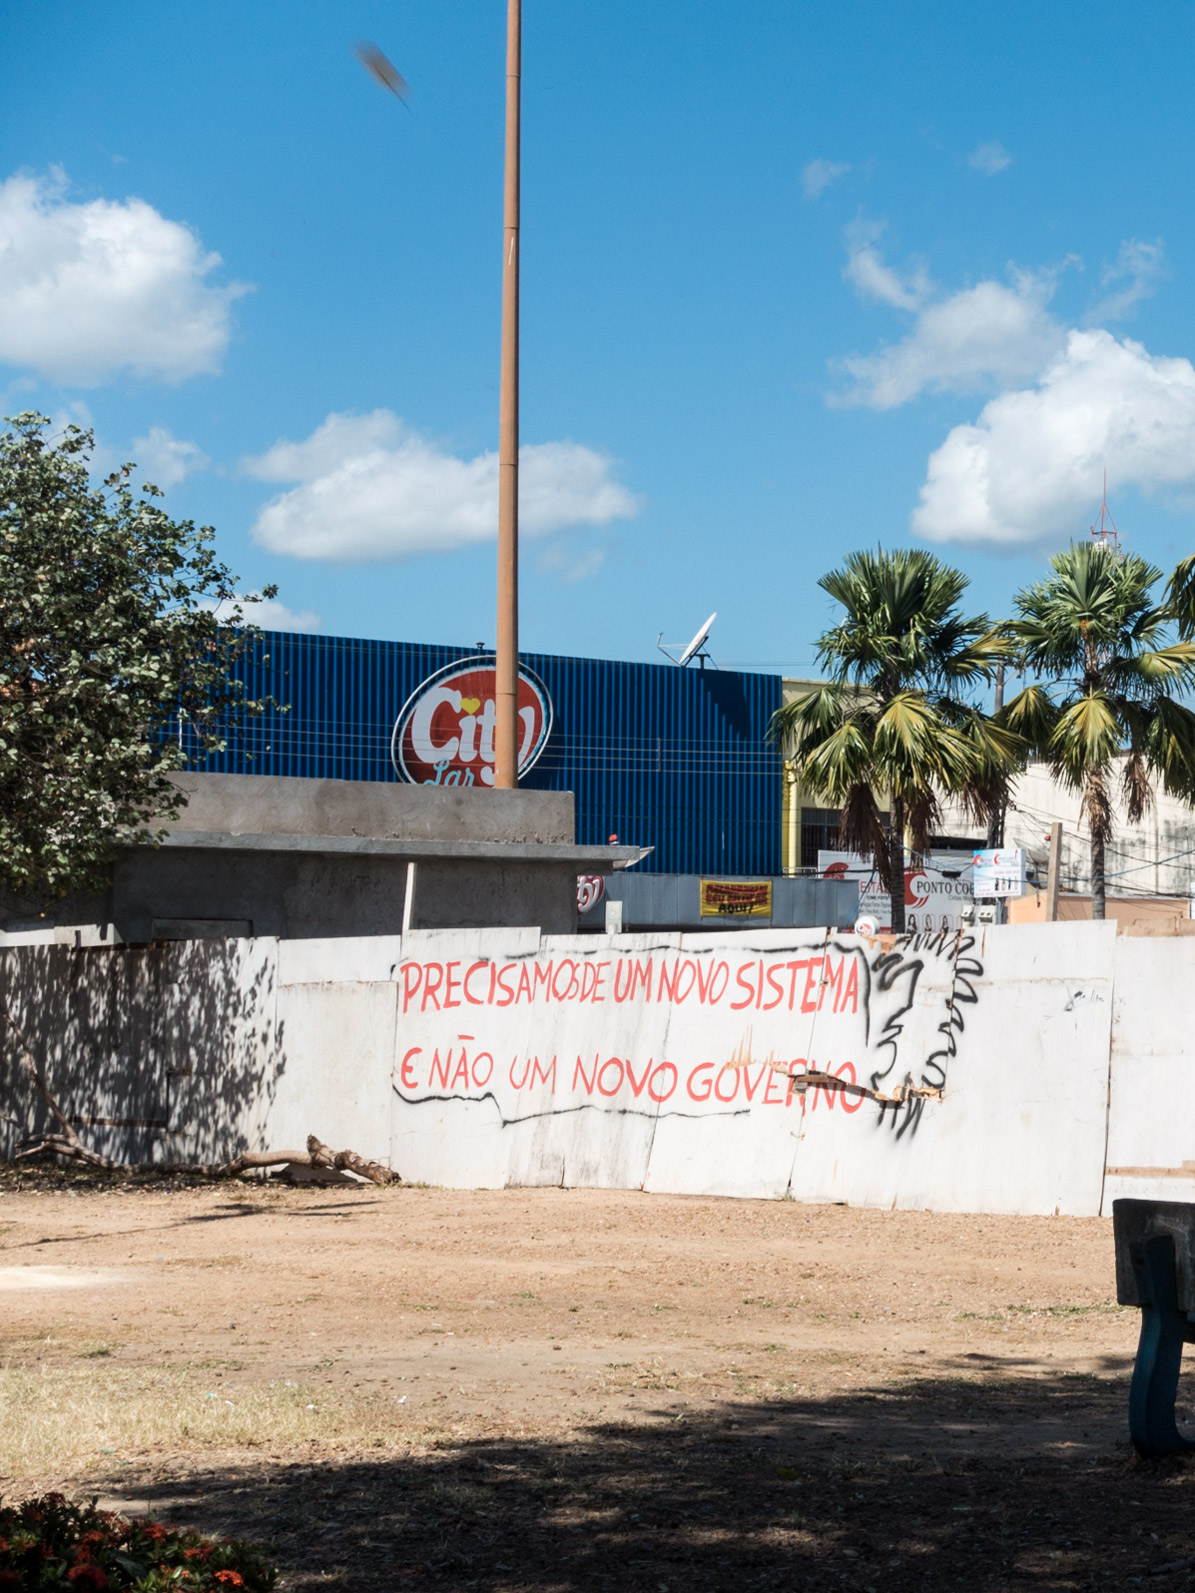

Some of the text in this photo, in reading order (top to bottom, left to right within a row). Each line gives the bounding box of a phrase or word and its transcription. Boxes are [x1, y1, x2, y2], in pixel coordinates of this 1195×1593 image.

[916, 881, 953, 895] PONTO
[613, 957, 653, 1004] UM
[656, 957, 730, 1005] NOVO
[730, 954, 858, 1014] SISTEMA
[401, 1034, 867, 1116] E NÃO UM NOVO GOVERNO
